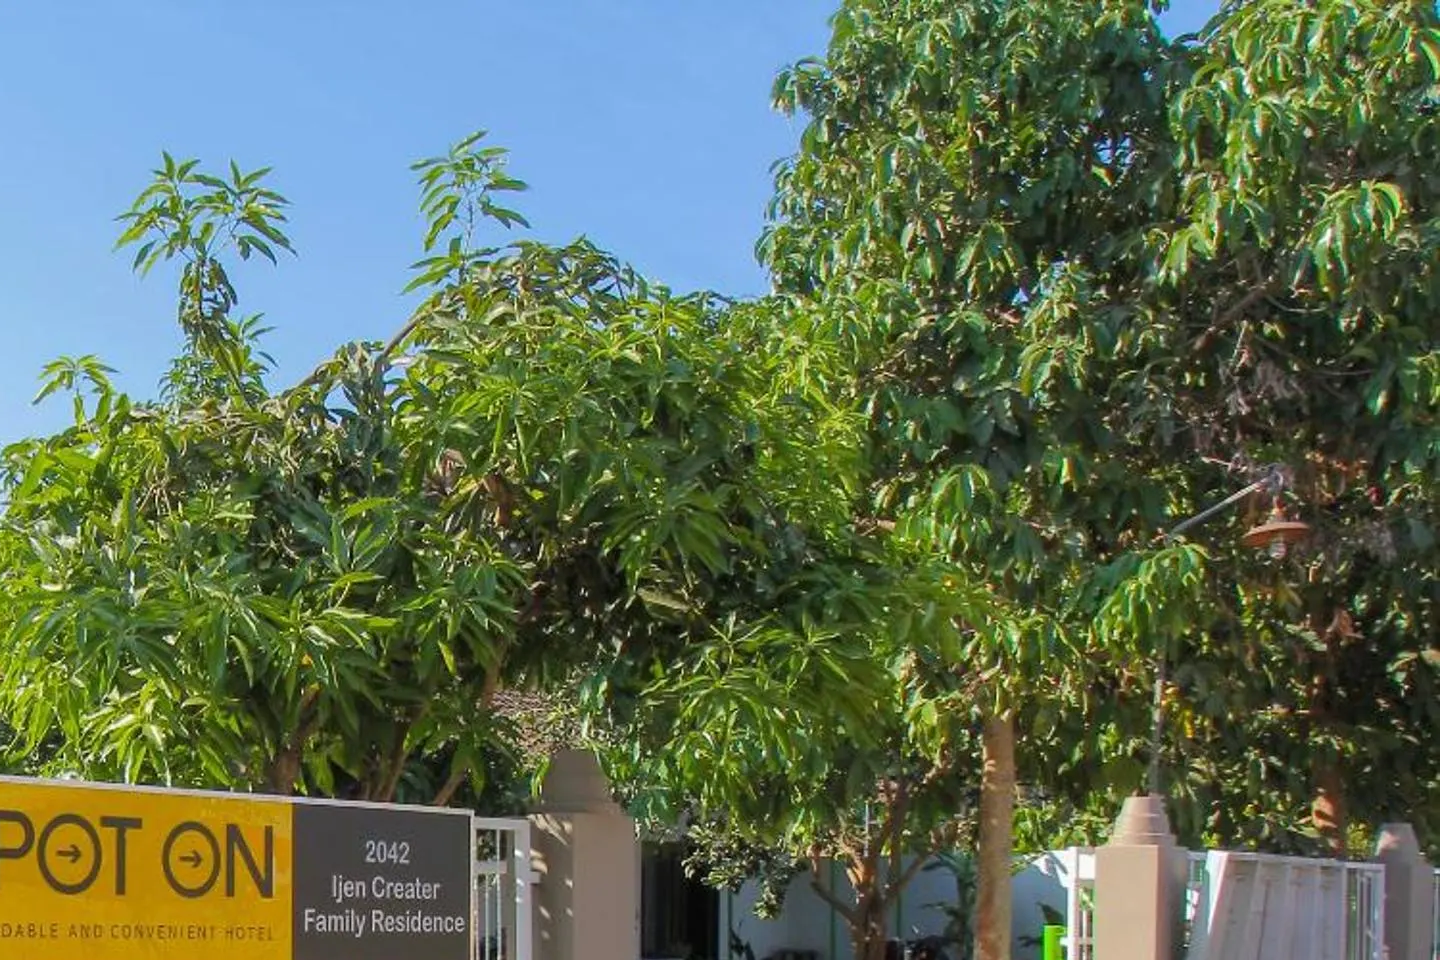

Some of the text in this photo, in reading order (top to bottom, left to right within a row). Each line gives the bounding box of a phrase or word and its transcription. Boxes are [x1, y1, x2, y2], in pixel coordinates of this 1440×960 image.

[162, 821, 274, 898] ON
[365, 840, 410, 864] 2042
[332, 875, 440, 903] Ijen Creater
[68, 923, 103, 939] AND
[110, 924, 215, 940] CONVENIENT
[225, 926, 273, 941] HOTEL
[304, 909, 465, 937] Family Residence
